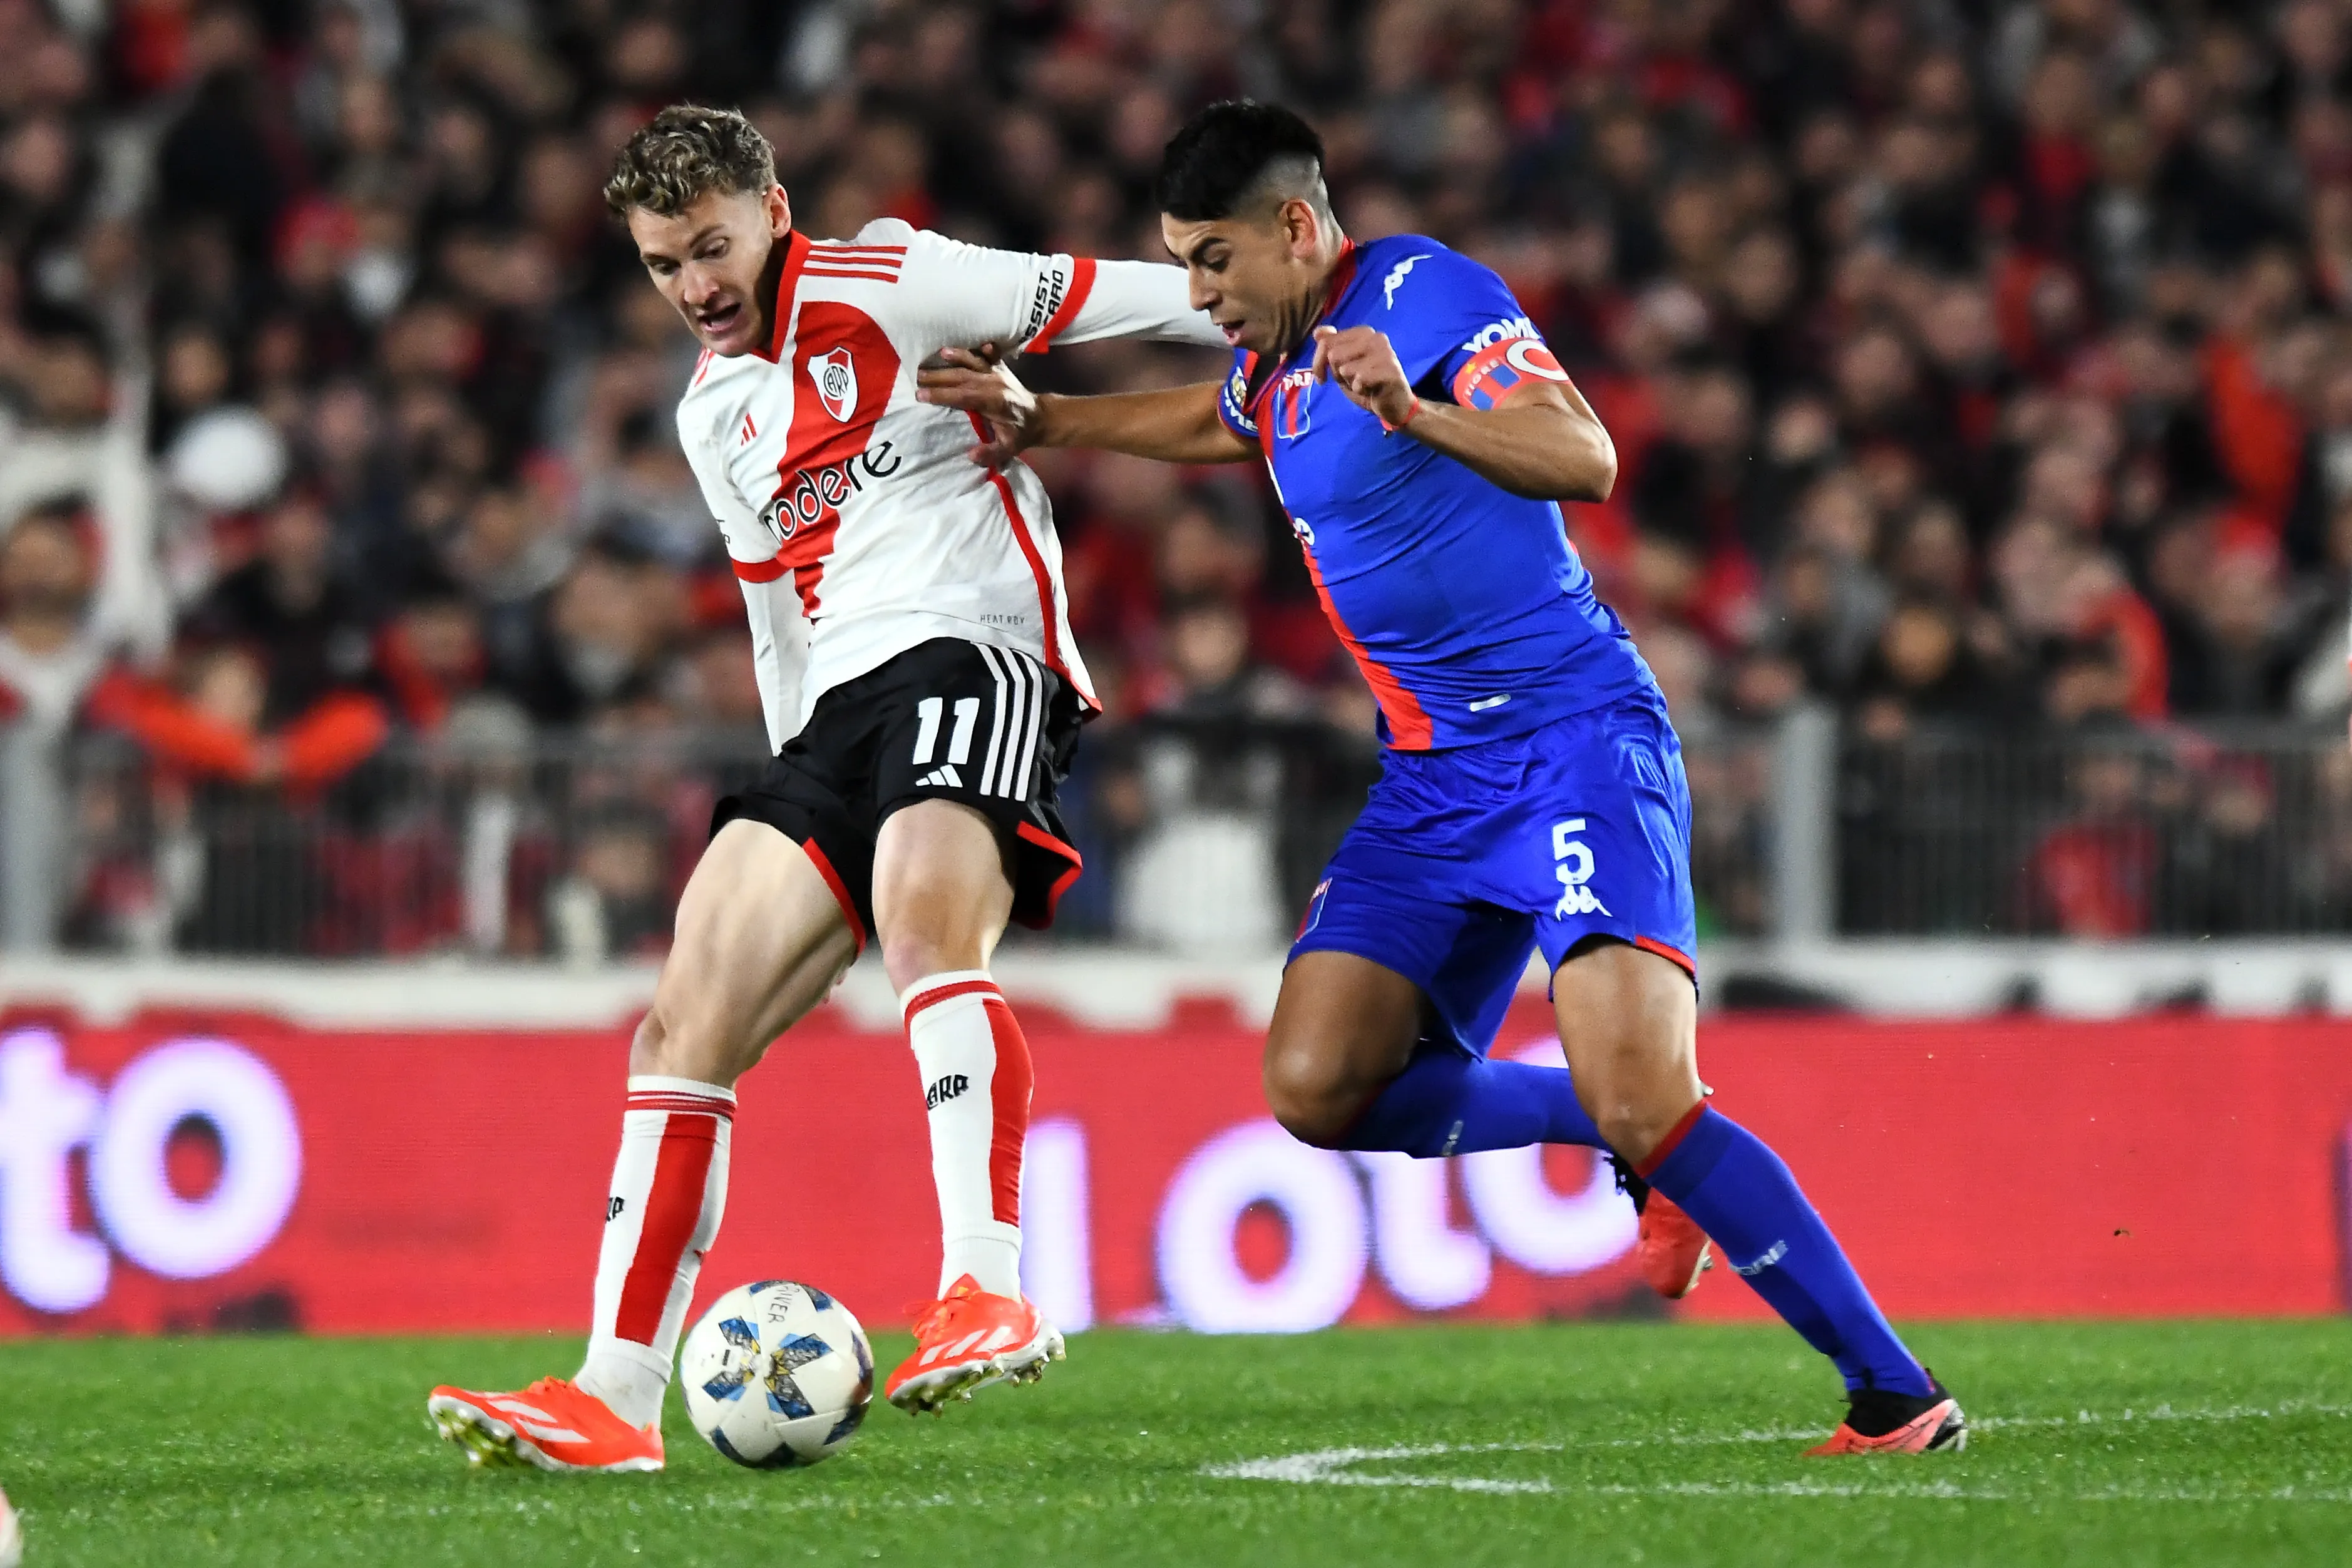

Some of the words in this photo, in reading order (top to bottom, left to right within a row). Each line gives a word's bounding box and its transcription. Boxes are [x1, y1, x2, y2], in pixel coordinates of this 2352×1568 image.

[980, 614, 1003, 624] HEAT
[912, 696, 980, 765] 11
[1552, 818, 1596, 884] 5
